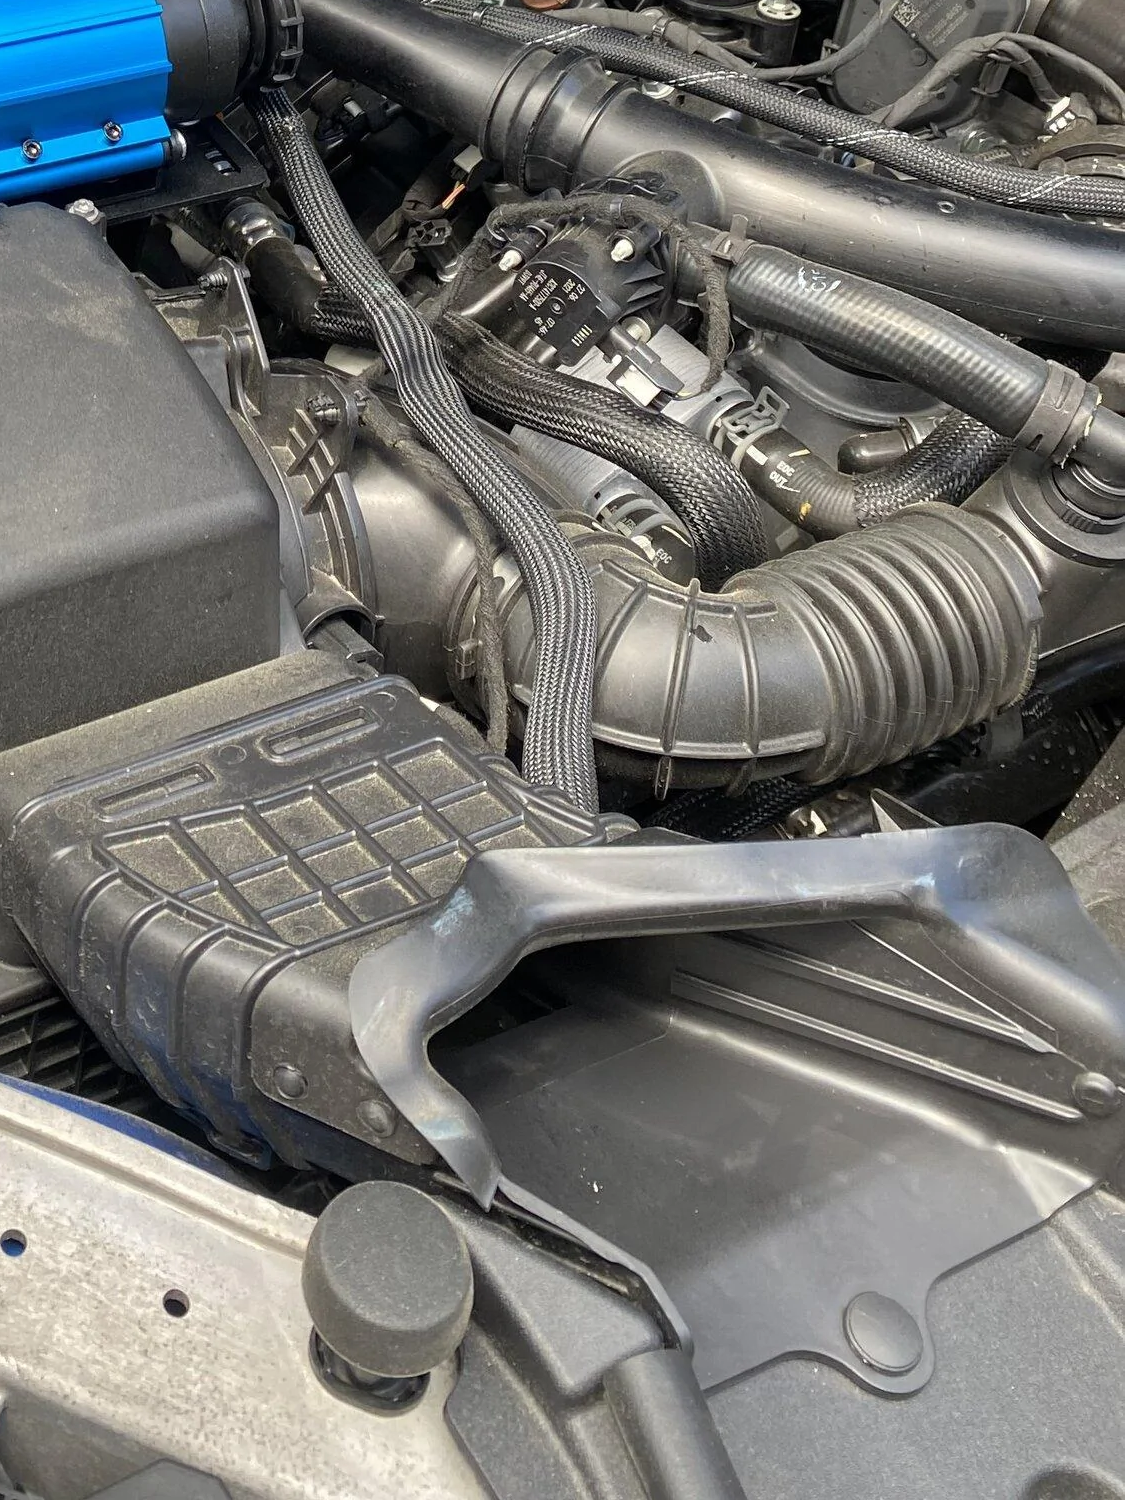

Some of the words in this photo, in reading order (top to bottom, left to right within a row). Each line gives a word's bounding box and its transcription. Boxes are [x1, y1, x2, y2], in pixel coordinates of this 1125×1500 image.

[776, 460, 795, 477] EOC
[769, 470, 788, 488] OUT
[656, 548, 673, 564] EOC
